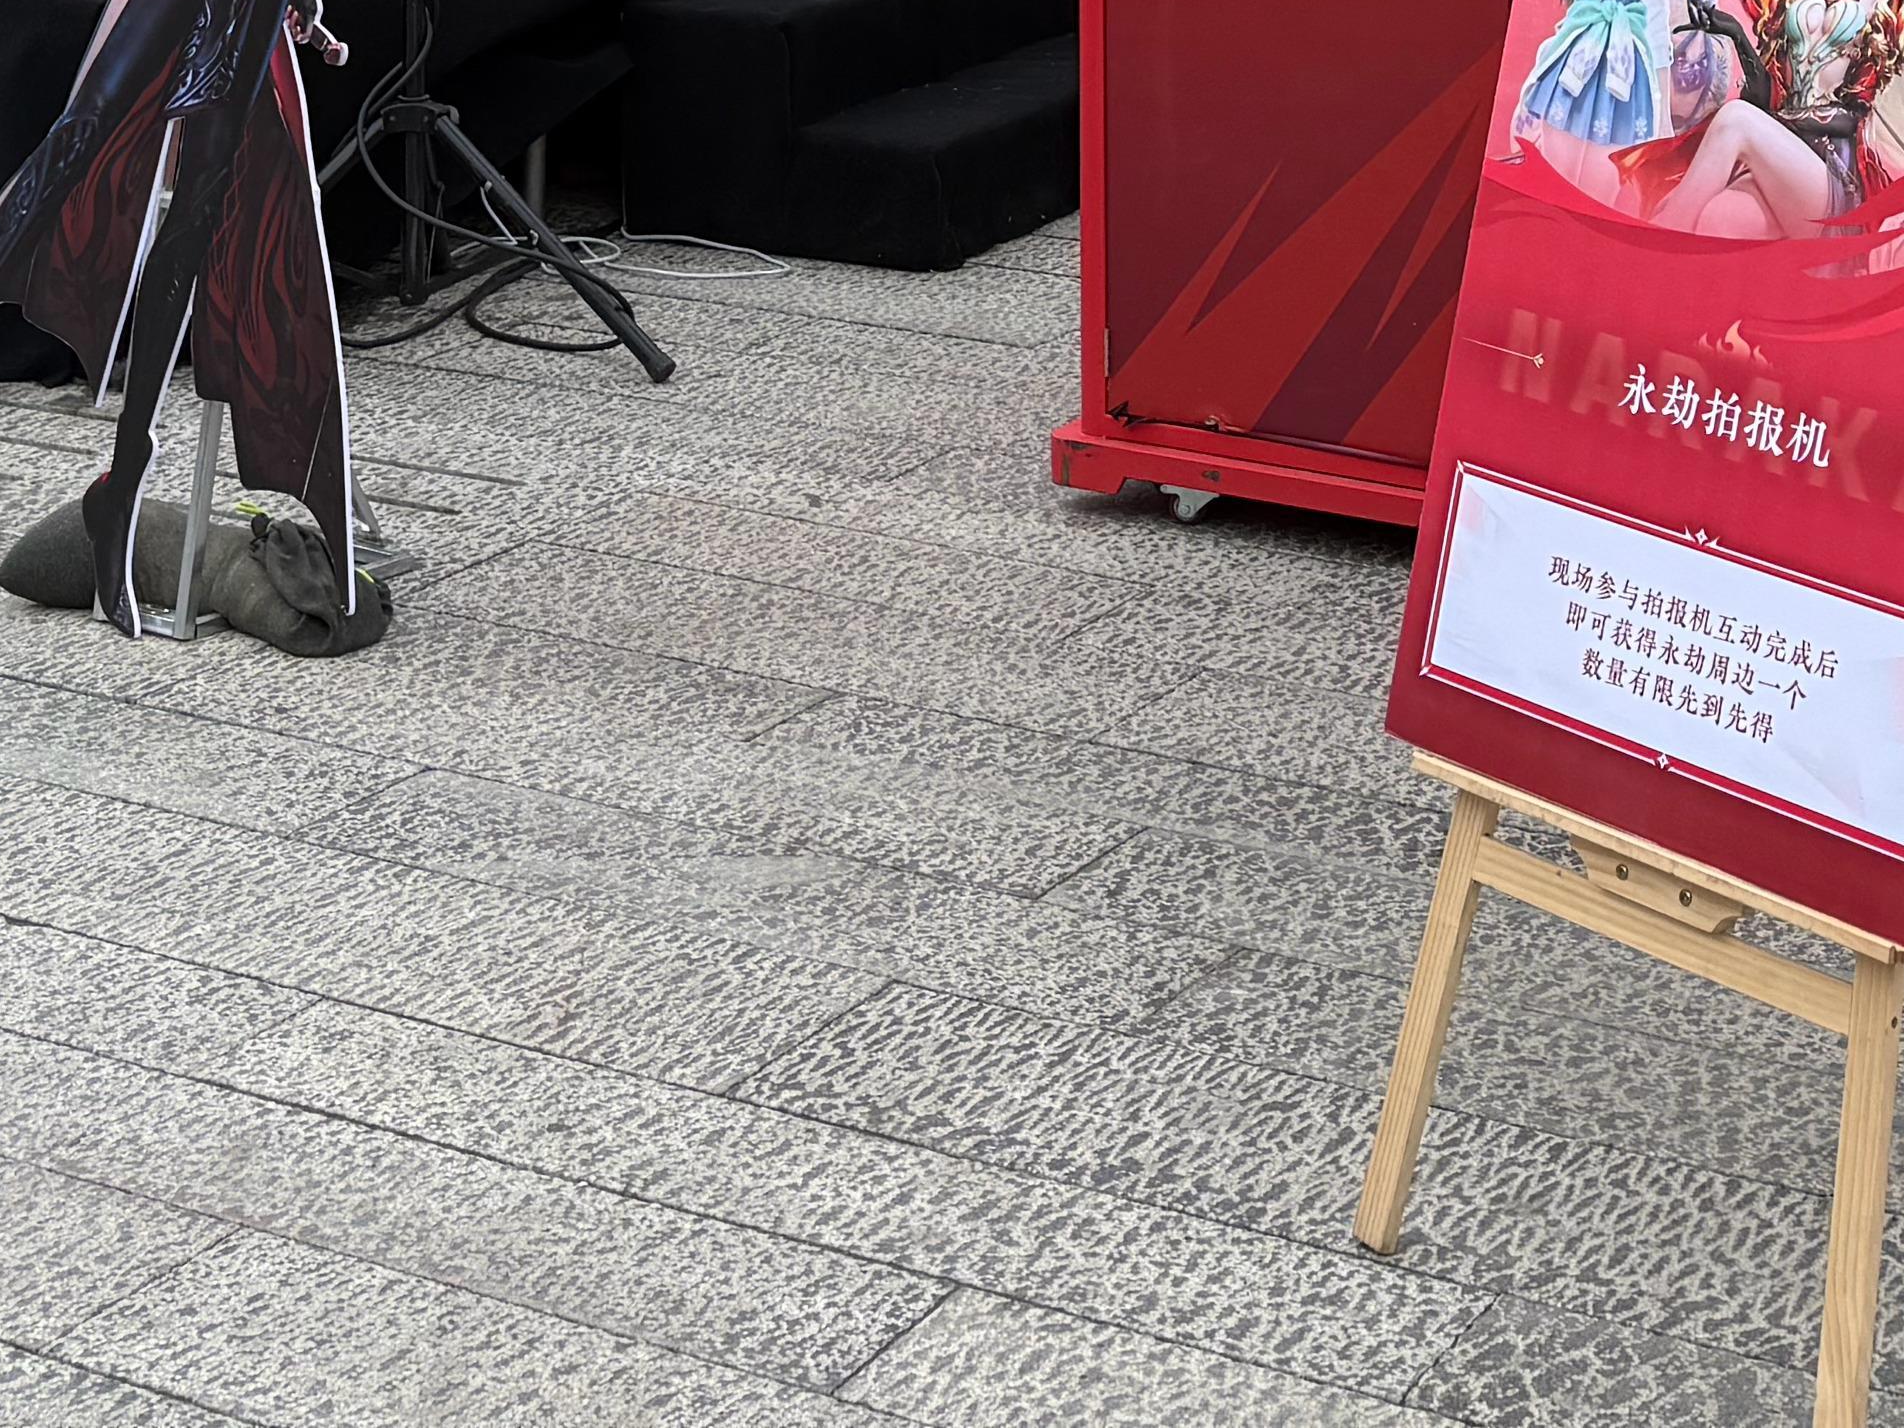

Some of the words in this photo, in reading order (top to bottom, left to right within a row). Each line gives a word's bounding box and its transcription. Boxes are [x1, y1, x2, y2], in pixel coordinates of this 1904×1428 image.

[1617, 362, 1832, 469] 永劫拍报机
[1548, 555, 1840, 680] 现场参与拍报机互动完成后
[1565, 600, 1809, 712] 即可获得永劫周边一个
[1580, 648, 1775, 745] 数量有限先到先得
